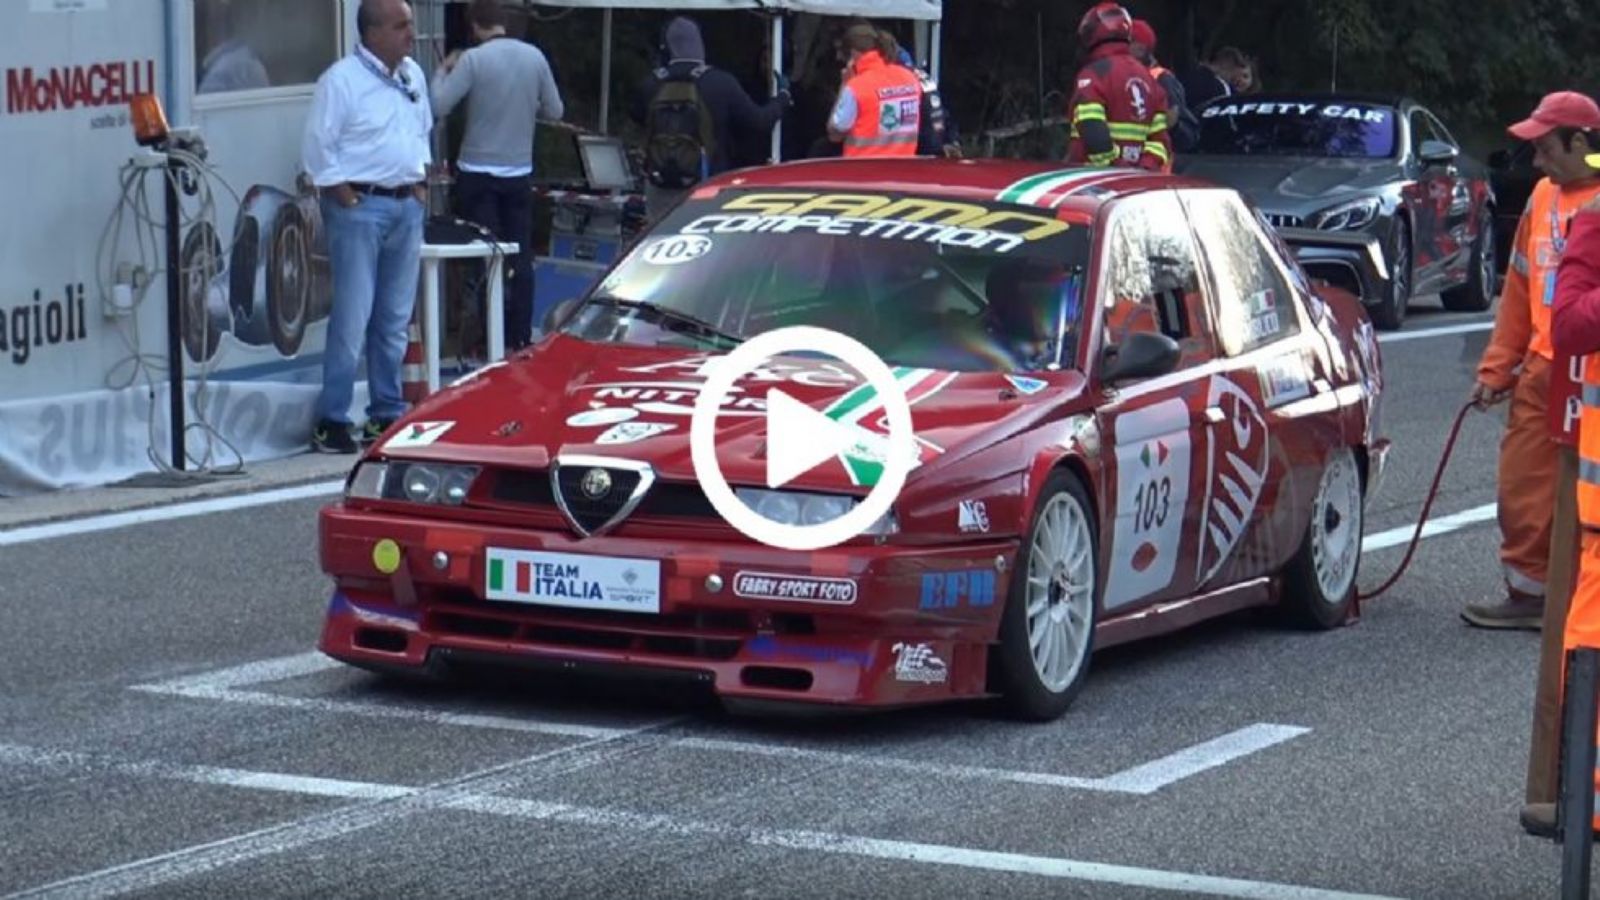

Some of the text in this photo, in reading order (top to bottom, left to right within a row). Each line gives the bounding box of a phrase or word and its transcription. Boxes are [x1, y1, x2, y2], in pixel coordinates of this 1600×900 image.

[7, 60, 154, 114] MoNACELLI
[1202, 103, 1386, 123] SAFETY CAR
[680, 214, 1024, 252] COMPETITION
[650, 240, 709, 260] 103
[1134, 476, 1171, 534] 103
[534, 562, 579, 578] TEAM
[535, 577, 603, 600] ITALIA
[740, 577, 852, 600] FABRY SPORT FOTO
